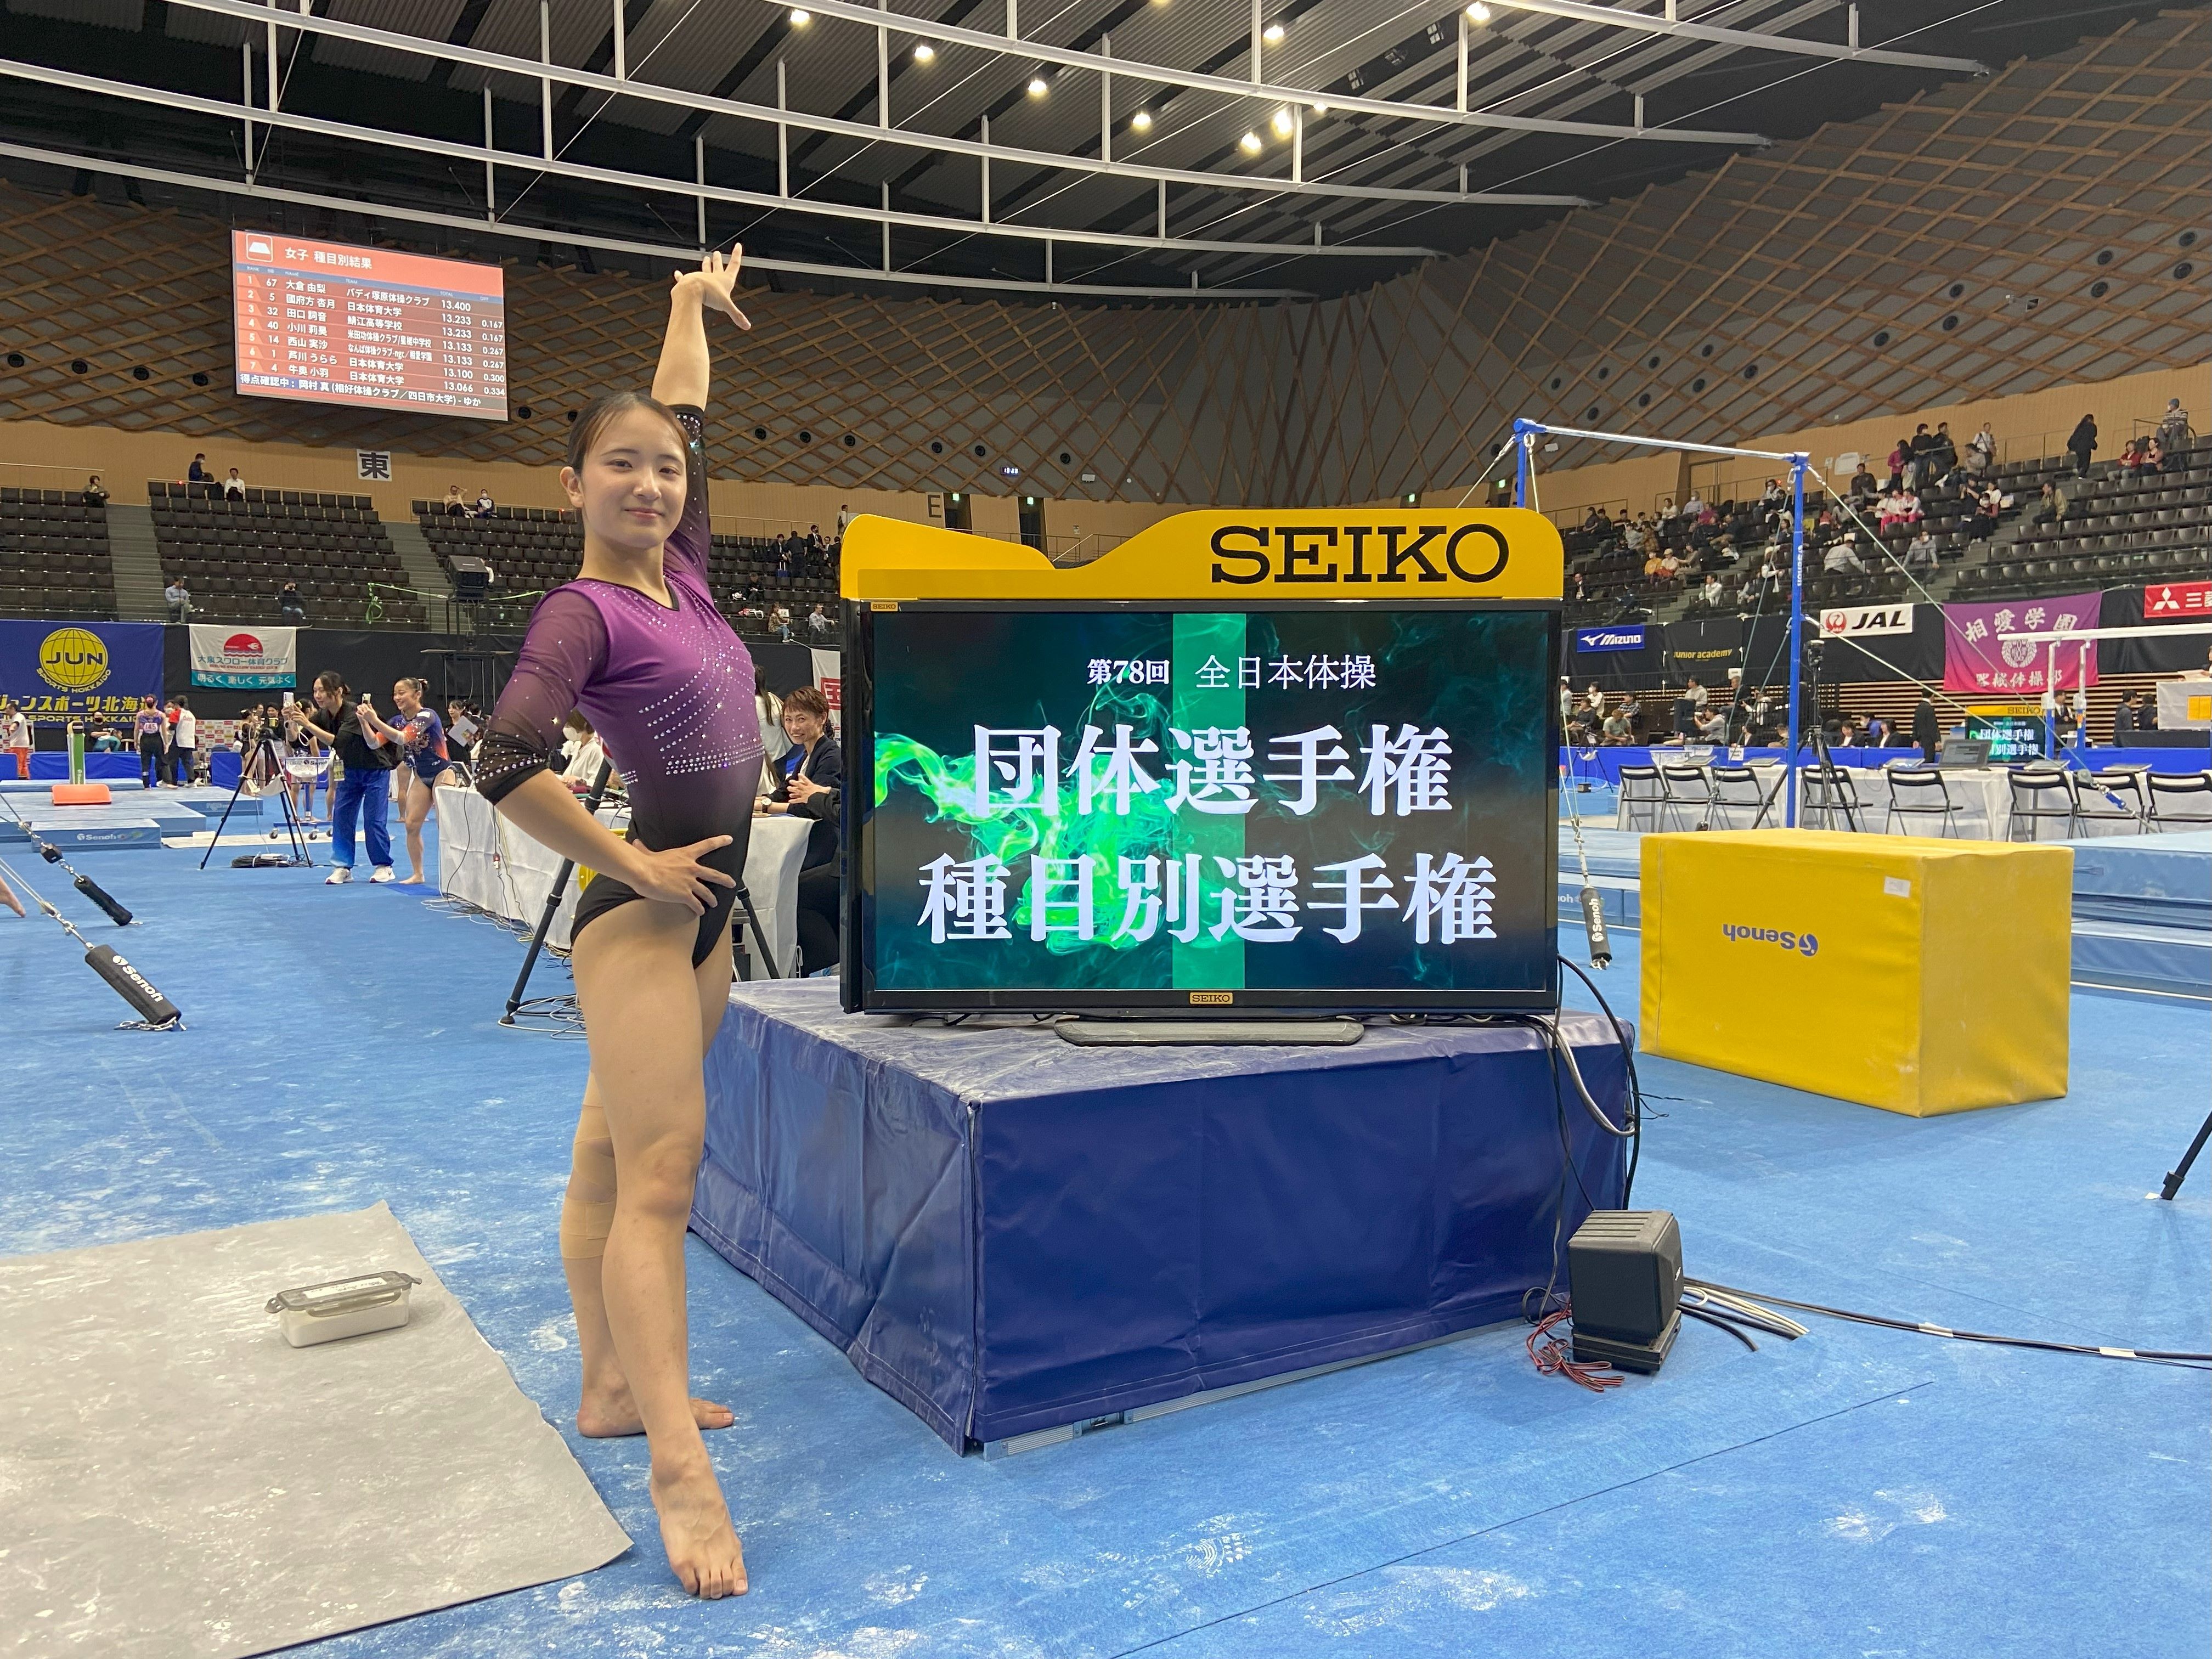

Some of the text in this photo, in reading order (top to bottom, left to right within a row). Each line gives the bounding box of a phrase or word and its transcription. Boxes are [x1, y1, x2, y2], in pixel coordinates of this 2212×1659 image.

[285, 247, 373, 269] 女子 種目別結果
[247, 290, 253, 298] 2
[269, 293, 275, 301] 5
[347, 301, 402, 317] 日本体育大学
[442, 313, 471, 325] 13.233
[482, 320, 503, 329] 0.167
[248, 276, 252, 284] 1
[266, 278, 277, 287] 67
[286, 279, 304, 291] 大倉
[441, 300, 471, 312] 13.400
[249, 304, 254, 313] 3
[267, 307, 278, 315] 32
[286, 308, 305, 319] 田口
[442, 327, 472, 338] 13.233
[482, 333, 504, 342] 0.167
[249, 318, 255, 327] 4
[267, 321, 279, 330] 40
[287, 322, 306, 334] 小川
[443, 340, 472, 352] 13.133
[482, 347, 504, 356] 0.267
[249, 333, 255, 341] 5
[268, 335, 279, 344] 14
[287, 336, 306, 347] 西山
[443, 354, 472, 366] 13.133
[483, 360, 504, 369] 0.267
[250, 347, 255, 356] 6
[272, 349, 276, 358] 1
[310, 353, 337, 365] うらら
[349, 357, 404, 372] 日本体育大学
[443, 368, 473, 379] 13.100
[483, 374, 505, 382] 0.300
[250, 362, 256, 370] 7
[271, 364, 278, 372] 4
[349, 371, 404, 386] 日本体育大学
[444, 381, 473, 392] 13.066
[484, 387, 505, 396] 0.334
[464, 396, 481, 407] ゆか
[359, 452, 390, 478] 東
[928, 494, 942, 518] E
[1210, 523, 1509, 584] SEIKO
[1852, 611, 1906, 630] JAL
[46, 652, 103, 665] JUN
[1087, 654, 1376, 690] 第78回 全日本体操
[36, 668, 111, 693] SPORTS HOKKAIDO
[198, 673, 223, 684] 明るく
[973, 723, 1453, 816] 団体選手権
[918, 852, 1497, 945] 種目別選手権
[1589, 898, 1602, 932] Senoh
[1723, 923, 1796, 950] Senoh
[122, 965, 163, 1002] Senoh
